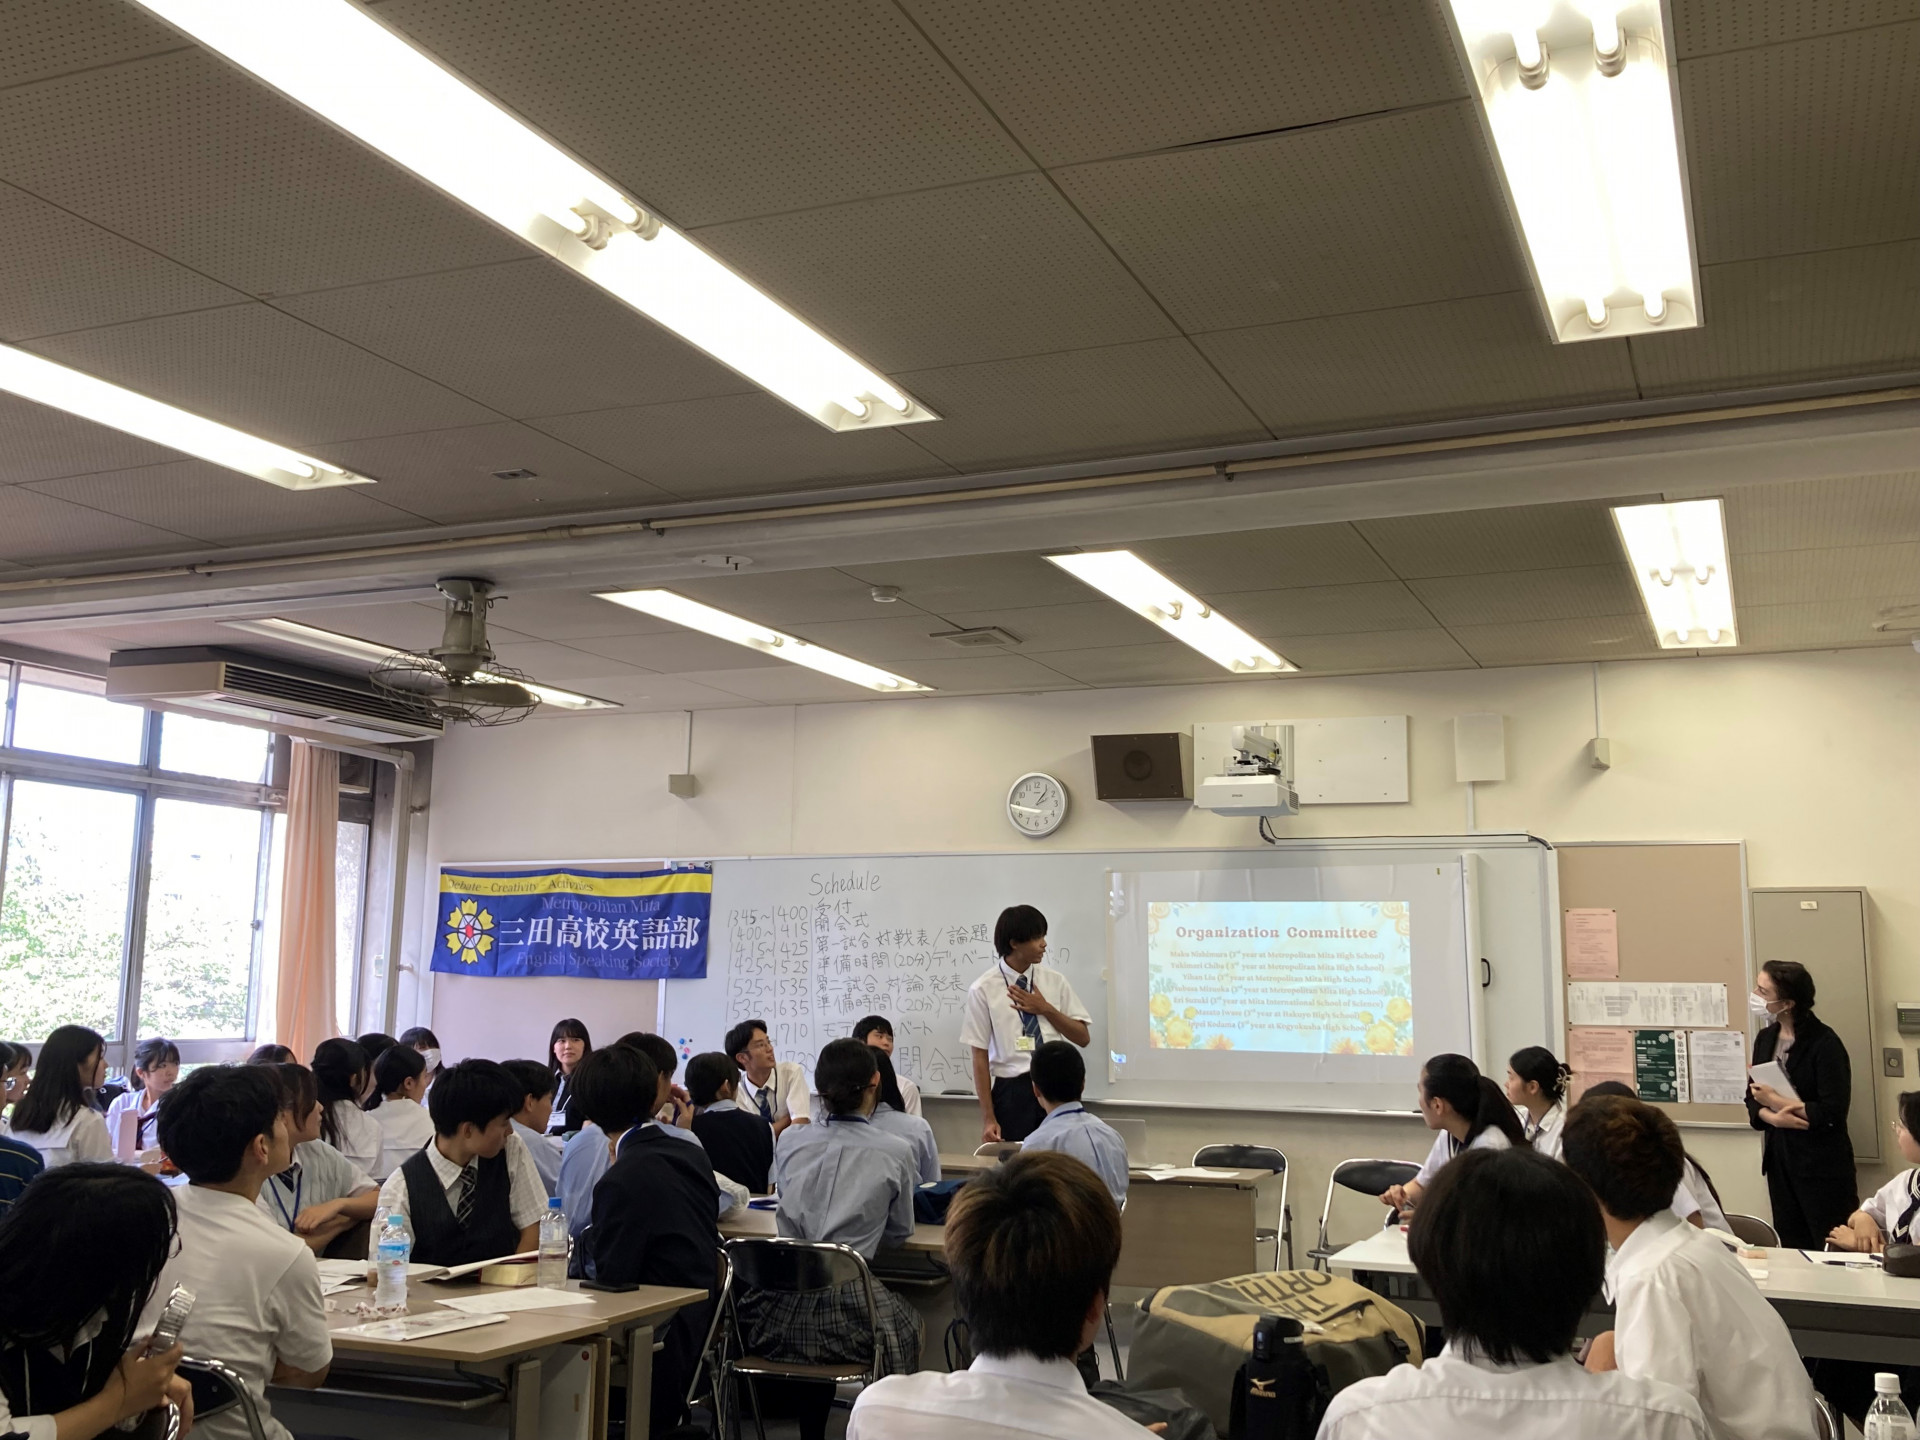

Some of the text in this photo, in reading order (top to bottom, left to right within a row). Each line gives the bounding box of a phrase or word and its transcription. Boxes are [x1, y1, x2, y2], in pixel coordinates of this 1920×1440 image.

[1034, 781, 1040, 789] 12
[449, 879, 481, 892] Debate
[491, 882, 537, 893] Creativity
[809, 871, 882, 897] Schedule
[542, 897, 660, 914] Metropolitan Mita
[814, 898, 852, 917] 受付
[499, 915, 700, 951] 三田高校英語部
[1175, 926, 1378, 941] Organization Committee
[516, 951, 682, 970] English Speaking Society
[1242, 953, 1257, 961] year
[1267, 951, 1315, 961] Metropolitan
[1336, 952, 1354, 962] High
[1355, 952, 1384, 961] School)
[1267, 963, 1315, 973] Metropolitan
[1317, 963, 1335, 971] Mita
[1336, 963, 1354, 974] High
[1355, 963, 1384, 973] School)
[1230, 976, 1245, 984] year
[1256, 974, 1303, 985] Metropolitan
[1304, 975, 1322, 983] Mita
[1323, 975, 1342, 985] High
[1343, 976, 1372, 984] School)
[1244, 988, 1259, 996] year
[1270, 986, 1317, 997] Metropolitan
[1319, 987, 1336, 995] Mita
[1338, 987, 1356, 997] High
[1358, 988, 1387, 996] School)
[1223, 999, 1238, 1007] year
[1248, 997, 1265, 1006] Mita
[1267, 998, 1315, 1007] International
[1317, 998, 1341, 1007] School
[1343, 998, 1351, 1007] of
[1352, 998, 1384, 1009] Science)
[1257, 1010, 1272, 1018] year
[1312, 1009, 1330, 1020] High
[1332, 1010, 1360, 1019] School)
[1207, 1019, 1236, 1028] Kodama
[1250, 1022, 1266, 1030] year
[1322, 1021, 1340, 1032] High
[1342, 1022, 1370, 1031] School)
[899, 1046, 974, 1083] 閉会式
[1240, 1271, 1332, 1305] ORTH
